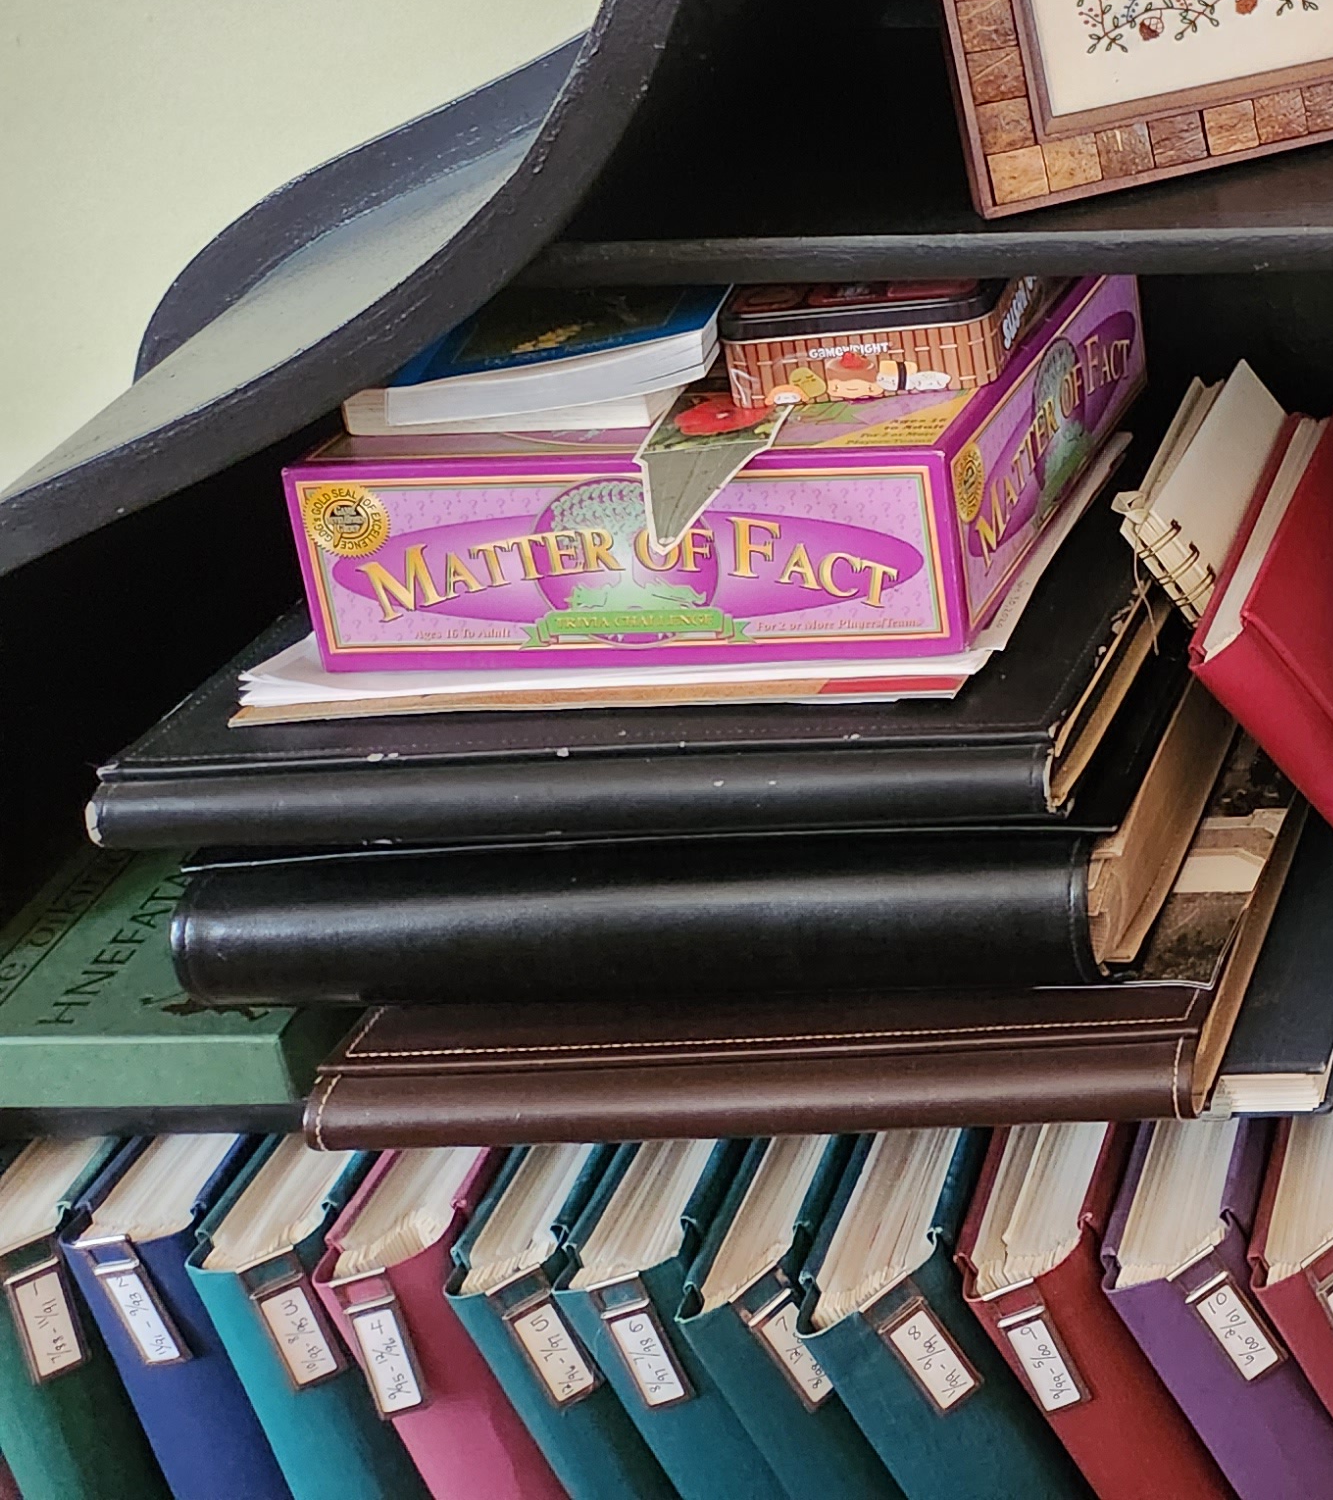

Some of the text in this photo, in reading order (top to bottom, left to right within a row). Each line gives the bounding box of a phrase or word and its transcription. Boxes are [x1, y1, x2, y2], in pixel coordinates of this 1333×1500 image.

[975, 397, 1060, 577] MATTER
[1060, 366, 1084, 419] OF
[1084, 336, 1130, 397] FACT
[331, 488, 357, 500] SEAL
[311, 492, 331, 516] GOLD
[362, 498, 377, 510] OF
[340, 511, 382, 551] EXCELLENCE
[355, 528, 627, 623] MATTER
[633, 528, 714, 572] OF
[725, 516, 899, 609] FACT
[555, 613, 715, 628] TRIVIA CHALLENGE
[756, 620, 777, 631] For
[804, 619, 836, 631] More
[414, 628, 442, 640] Ages
[449, 628, 459, 638] 16
[477, 627, 511, 638] Adult
[116, 1274, 129, 1287] 2
[281, 1299, 298, 1316] 3
[1207, 1292, 1227, 1314] 10
[370, 1319, 383, 1334] 4
[530, 1314, 549, 1332] 5
[628, 1320, 643, 1333] 6
[775, 1315, 788, 1332] 7
[907, 1325, 921, 1340] 8
[1020, 1323, 1037, 1340] 9
